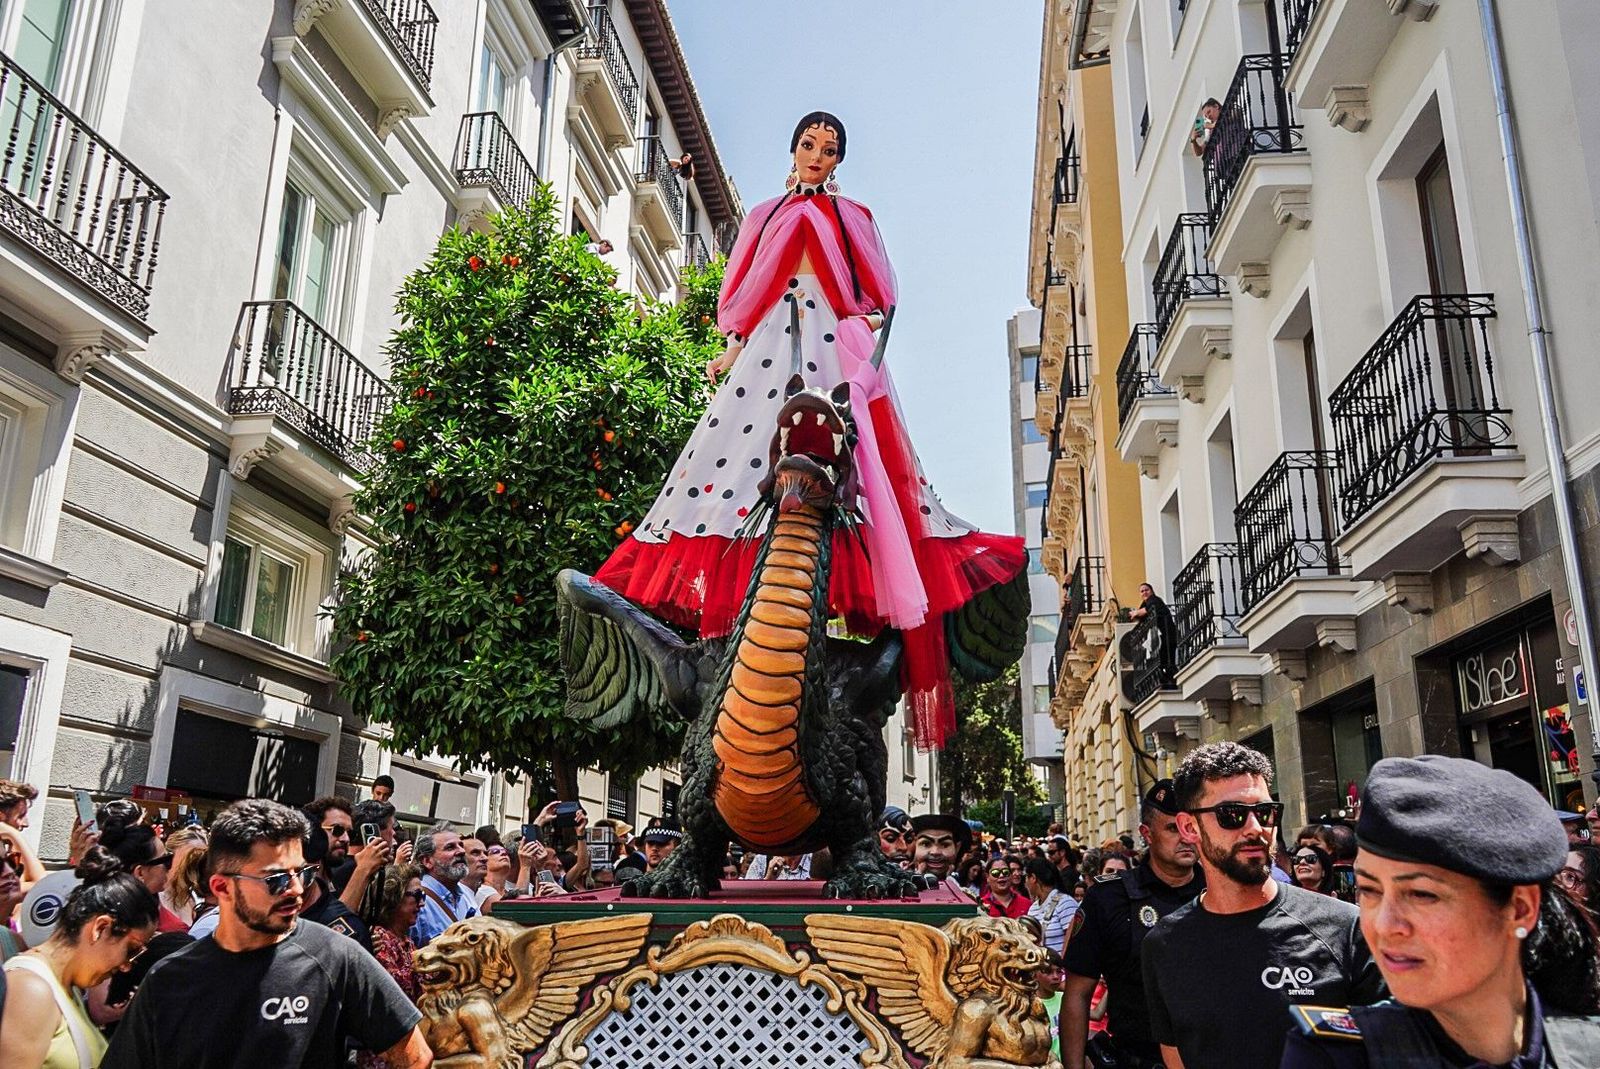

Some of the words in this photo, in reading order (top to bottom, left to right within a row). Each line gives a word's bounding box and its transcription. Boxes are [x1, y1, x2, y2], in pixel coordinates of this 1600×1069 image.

[1465, 651, 1519, 710] Siloé
[1261, 966, 1314, 990] CAO
[1288, 988, 1315, 996] servicios
[260, 995, 310, 1021] CAO
